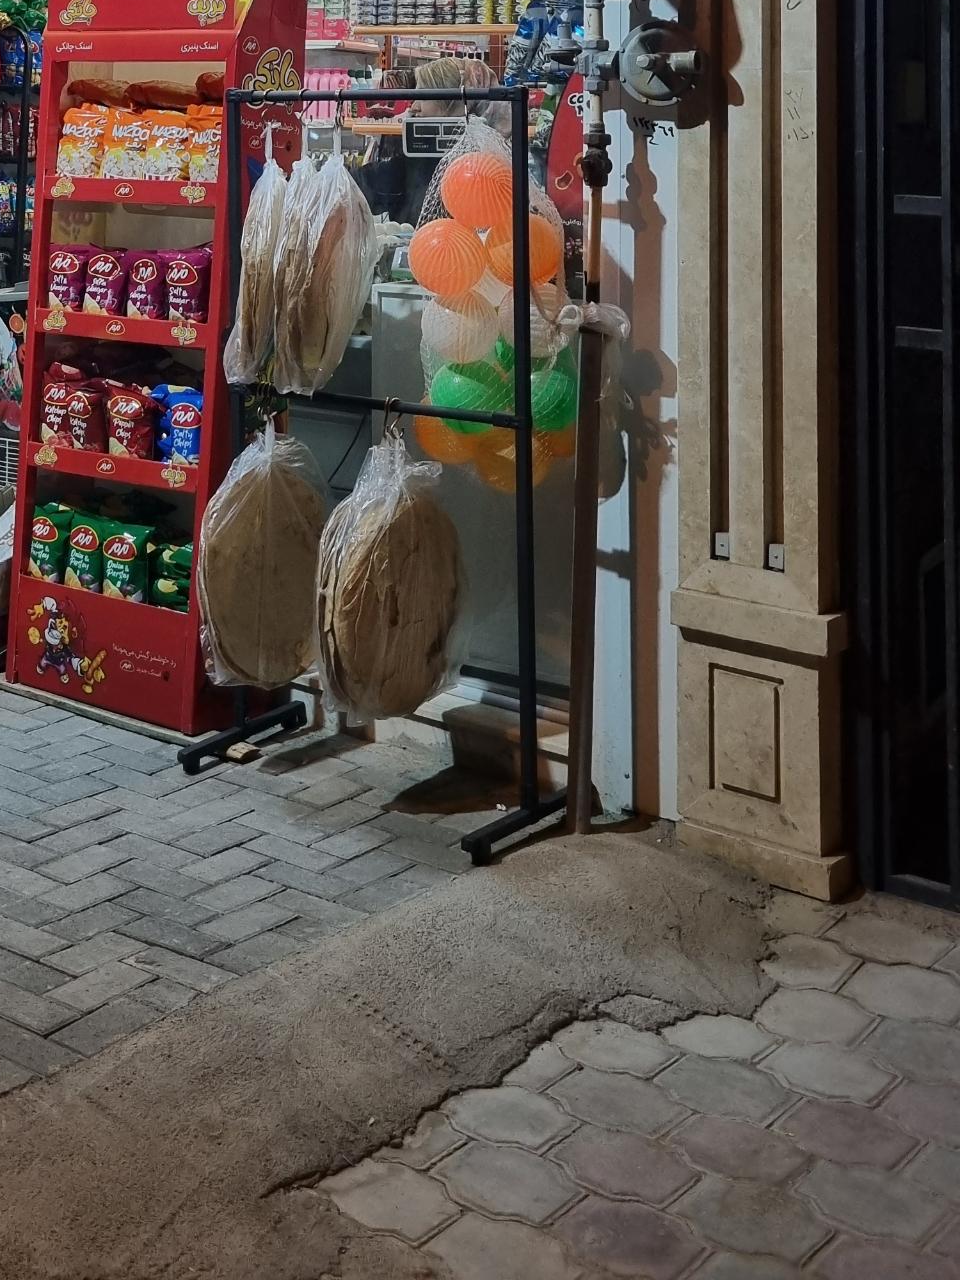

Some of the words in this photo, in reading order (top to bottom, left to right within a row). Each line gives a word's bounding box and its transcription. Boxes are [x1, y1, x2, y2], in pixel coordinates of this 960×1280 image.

[75, 41, 93, 50] اسنک
[181, 42, 199, 53] پنیری
[200, 41, 219, 50] اسنک
